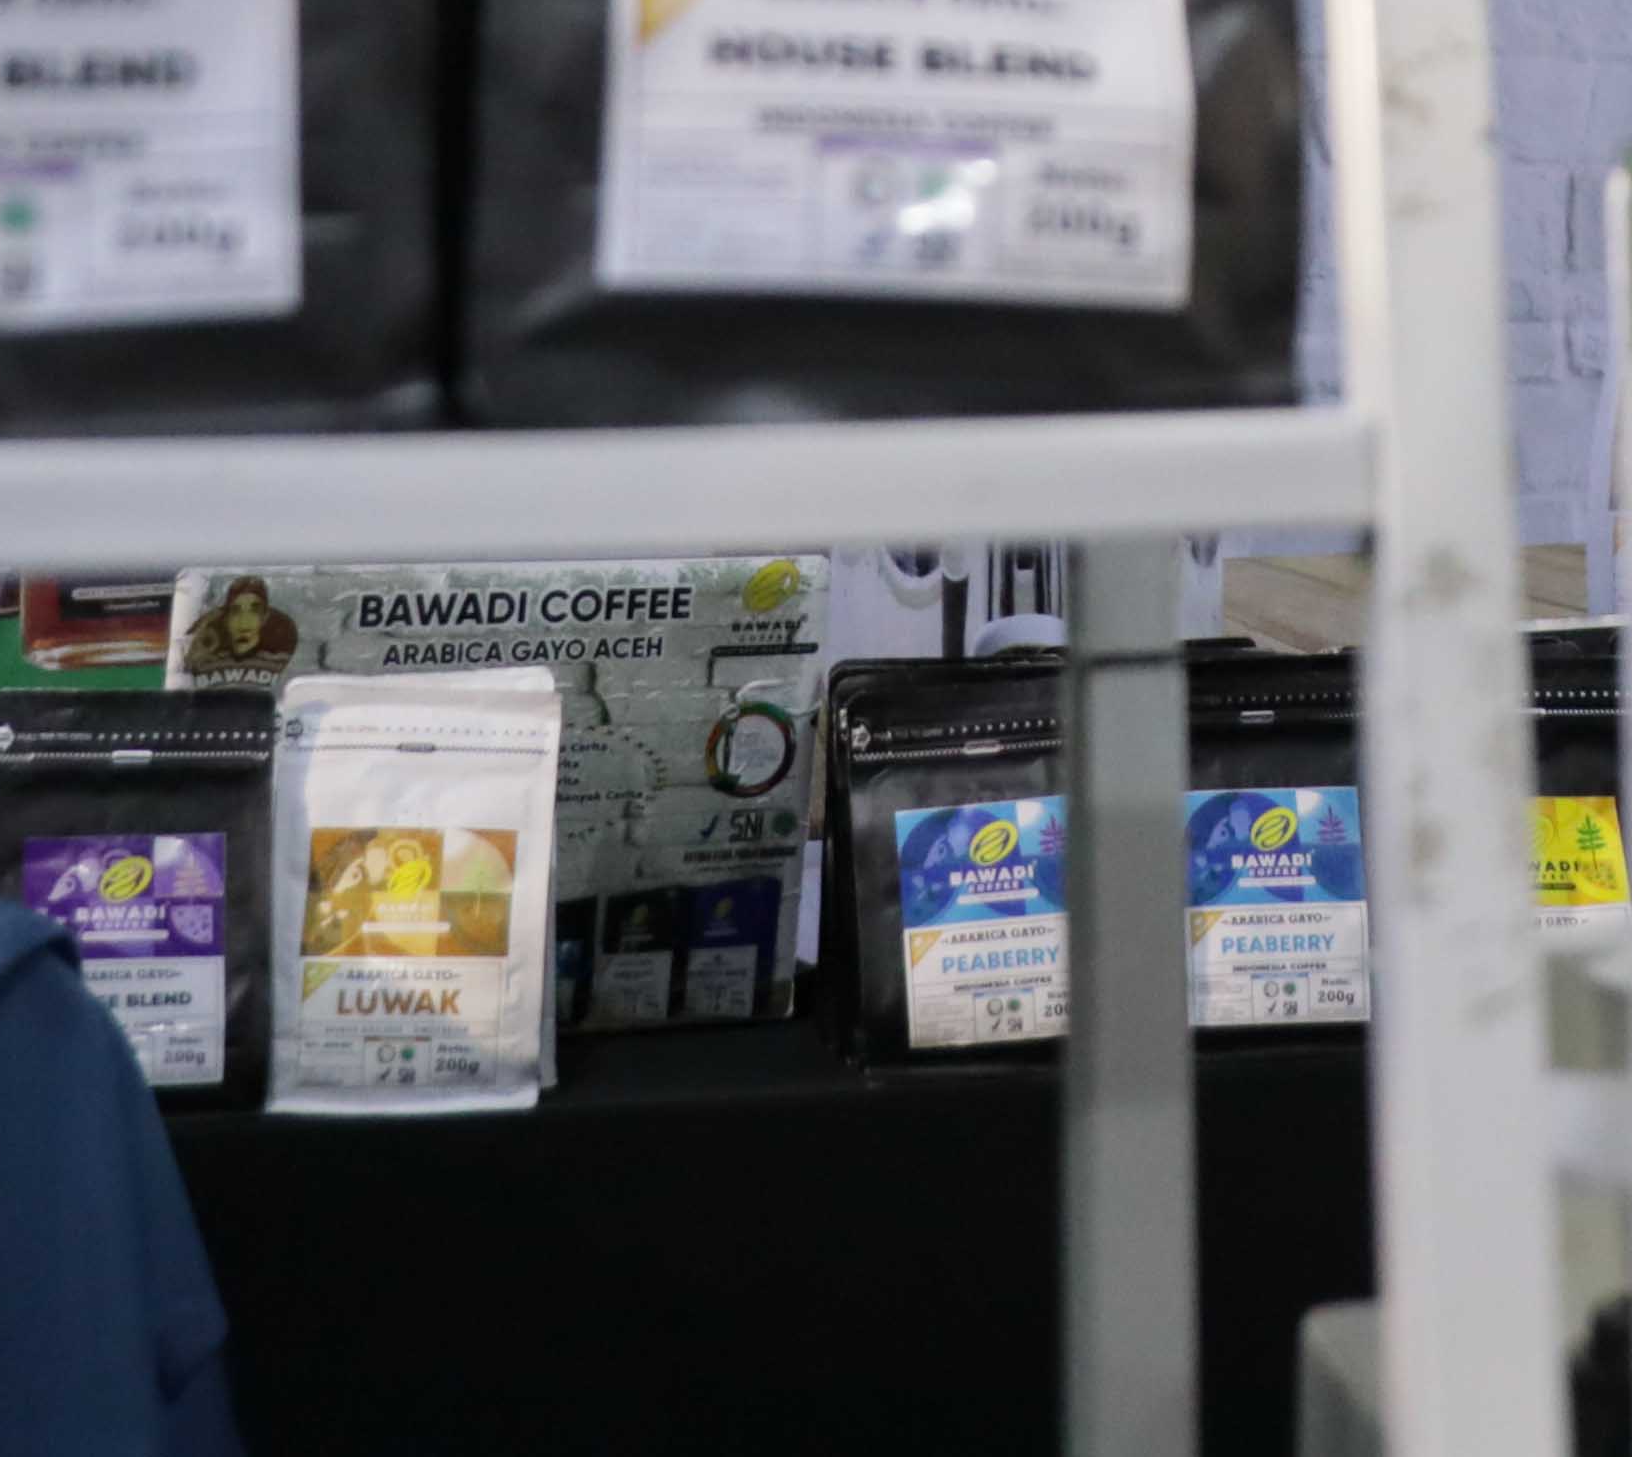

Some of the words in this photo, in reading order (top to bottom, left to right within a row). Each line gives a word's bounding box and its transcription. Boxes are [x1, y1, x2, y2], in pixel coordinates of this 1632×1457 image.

[706, 29, 896, 74] HOUSE
[917, 38, 1098, 84] BLEND
[359, 591, 528, 628] BAWADI
[539, 586, 693, 623] COFFEE
[382, 641, 503, 667] ARABICA
[511, 638, 586, 662] GAYO
[593, 636, 663, 659] ACEH
[1231, 852, 1312, 870] BAWADI
[949, 864, 1035, 888] BAWADI
[74, 905, 166, 923] BAWADI
[1231, 915, 1285, 927] ARABICA
[1288, 913, 1323, 925] GAYO
[951, 928, 1008, 944] ARABICA
[1010, 925, 1046, 939] GAYO
[1221, 932, 1336, 955] PEABERRY
[941, 944, 1060, 974] PEABERRY
[125, 991, 193, 1008] BLEND
[336, 987, 462, 1017] LUWAK
[1317, 989, 1356, 1006] 200g
[434, 1056, 481, 1076] 200g
